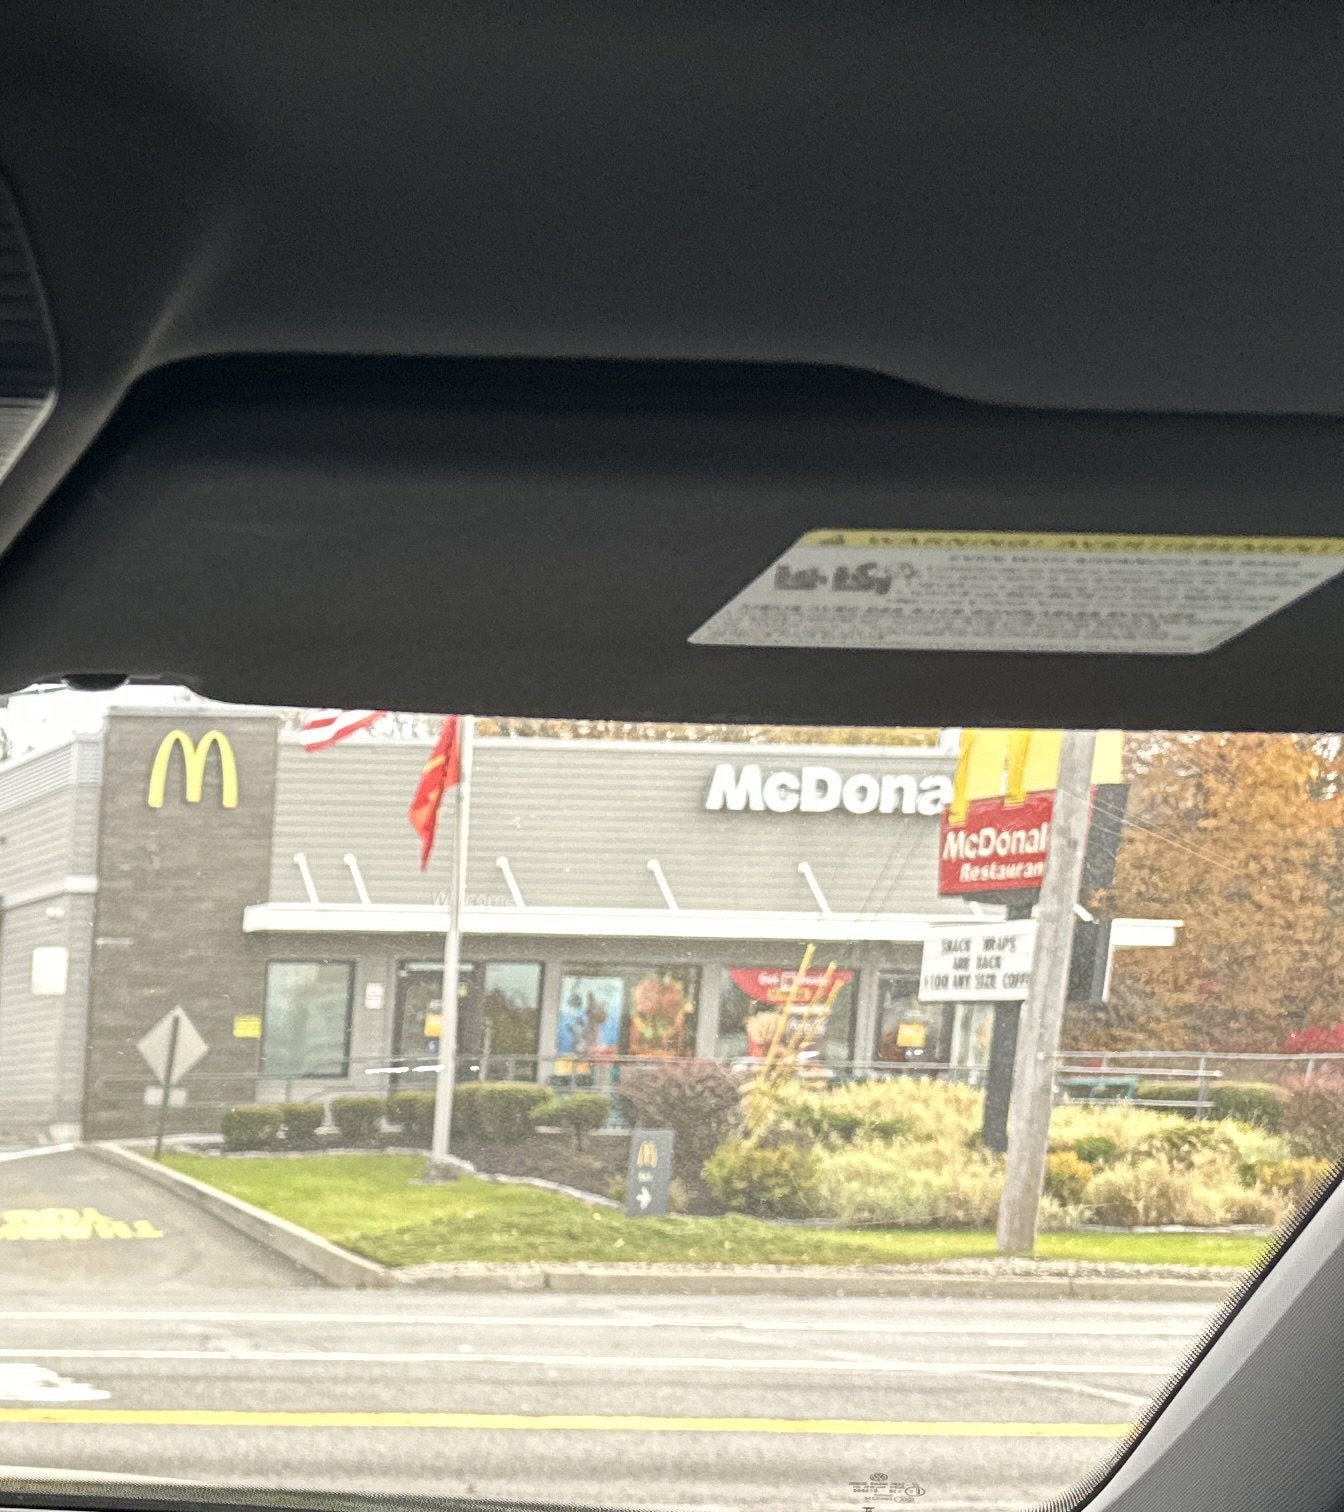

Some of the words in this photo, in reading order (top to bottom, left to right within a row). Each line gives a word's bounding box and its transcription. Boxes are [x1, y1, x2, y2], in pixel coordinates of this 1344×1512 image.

[705, 763, 954, 816] McDona
[942, 822, 1049, 861] McDonal
[959, 861, 1046, 882] Restauran
